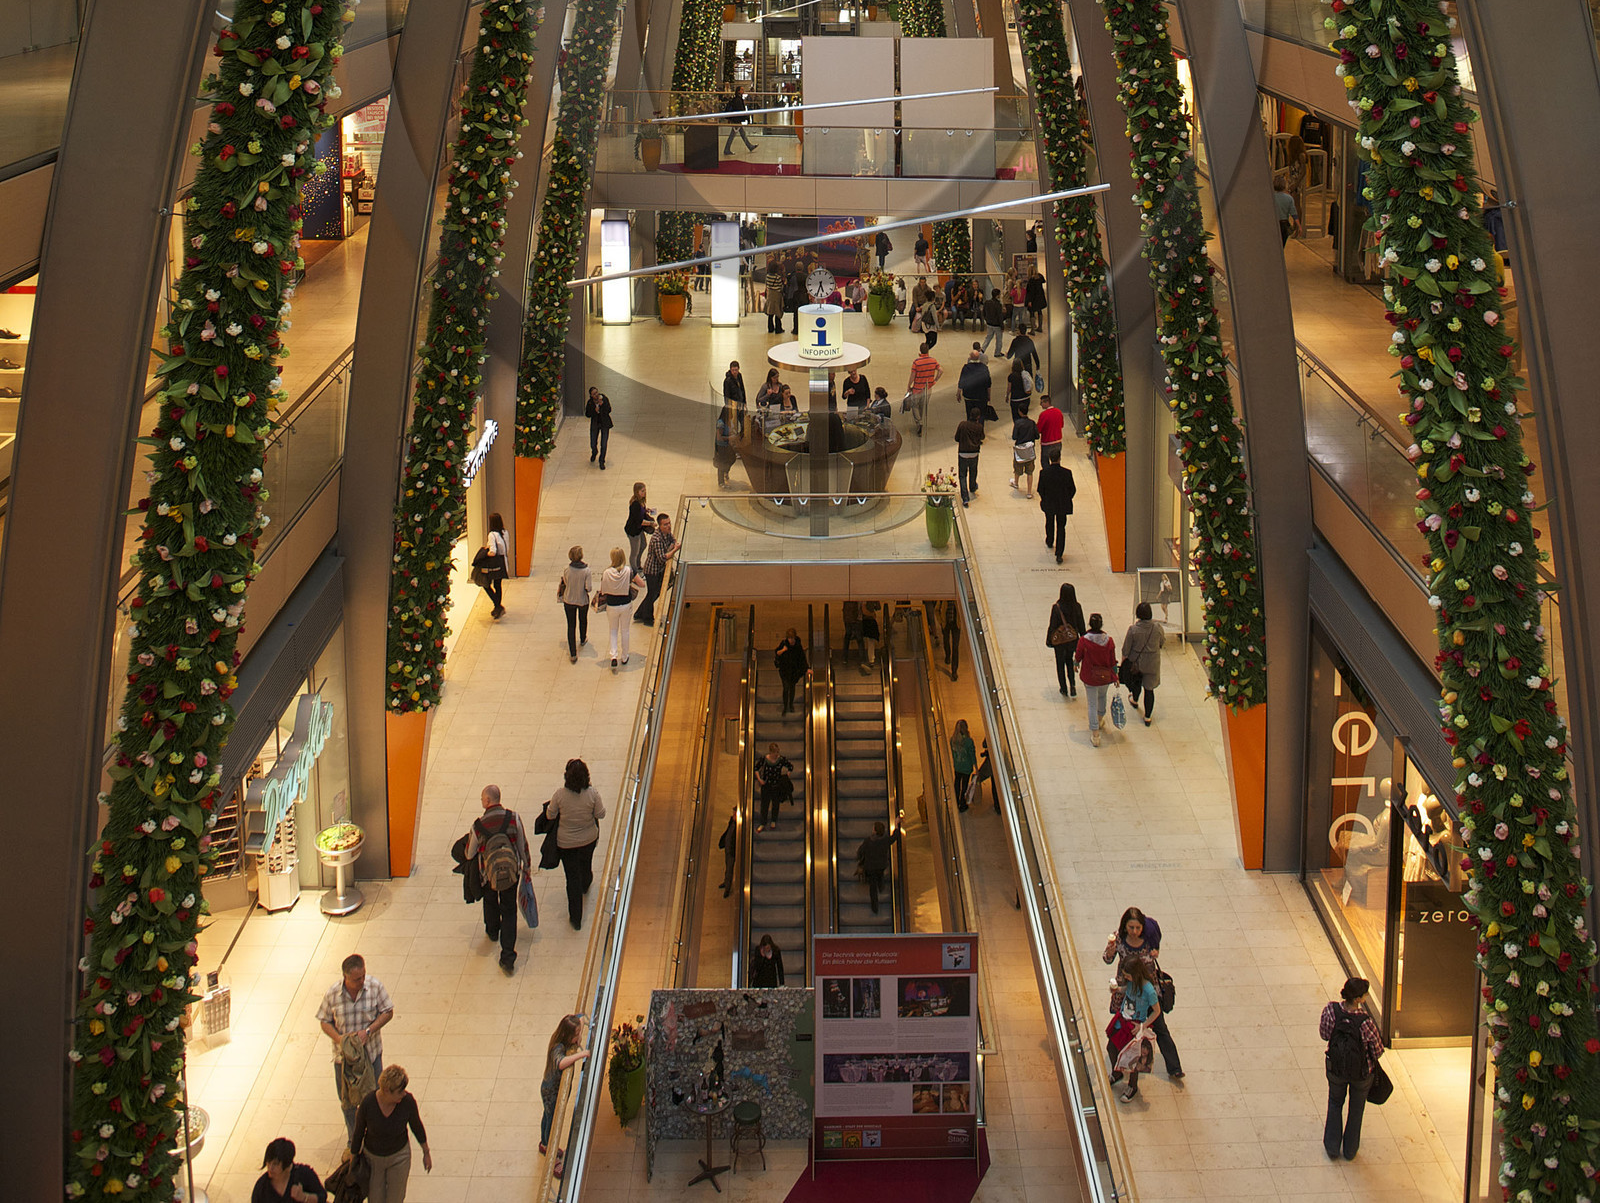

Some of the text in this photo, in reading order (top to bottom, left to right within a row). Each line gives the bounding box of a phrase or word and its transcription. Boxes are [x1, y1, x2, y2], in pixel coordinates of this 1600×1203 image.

[802, 347, 840, 357] INFOPOINT
[1420, 909, 1470, 924] zero
[947, 1135, 970, 1144] Stage
